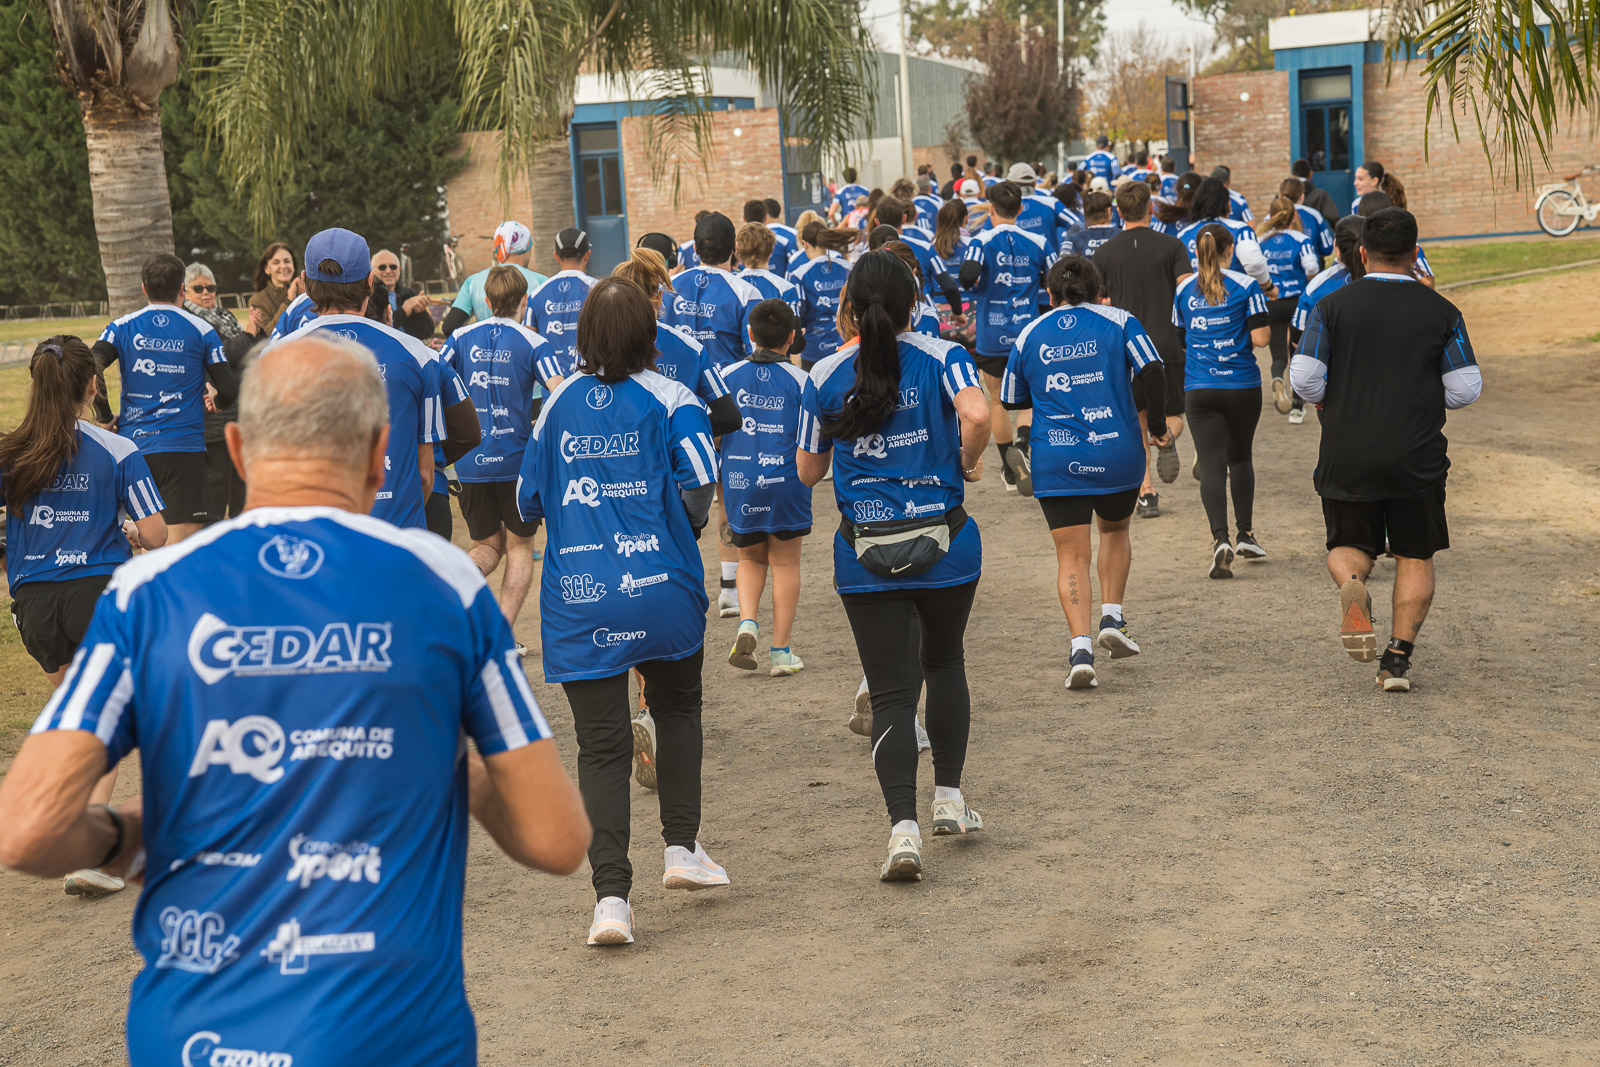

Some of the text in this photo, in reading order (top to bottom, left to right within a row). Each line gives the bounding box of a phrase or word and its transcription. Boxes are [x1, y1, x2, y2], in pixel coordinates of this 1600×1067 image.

[133, 333, 184, 352] CEDAR
[1039, 341, 1097, 365] CEDAR
[132, 359, 156, 376] AQ
[1045, 372, 1072, 392] AQ
[1072, 376, 1104, 385] AREQUITO
[736, 388, 785, 410] CEDAR
[886, 428, 928, 442] COMUNA DE
[888, 434, 929, 449] AREQUITO
[560, 430, 639, 464] CEDAR
[853, 433, 888, 459] AQ
[562, 477, 601, 508] AQ
[600, 481, 634, 490] COMUNA
[601, 487, 648, 498] AREQUITO
[559, 543, 604, 555] GRIBOM
[188, 613, 392, 685] CEDAR
[290, 727, 394, 746] COMUNA DE
[188, 715, 285, 784] AQ
[290, 741, 393, 761] AREQUITO
